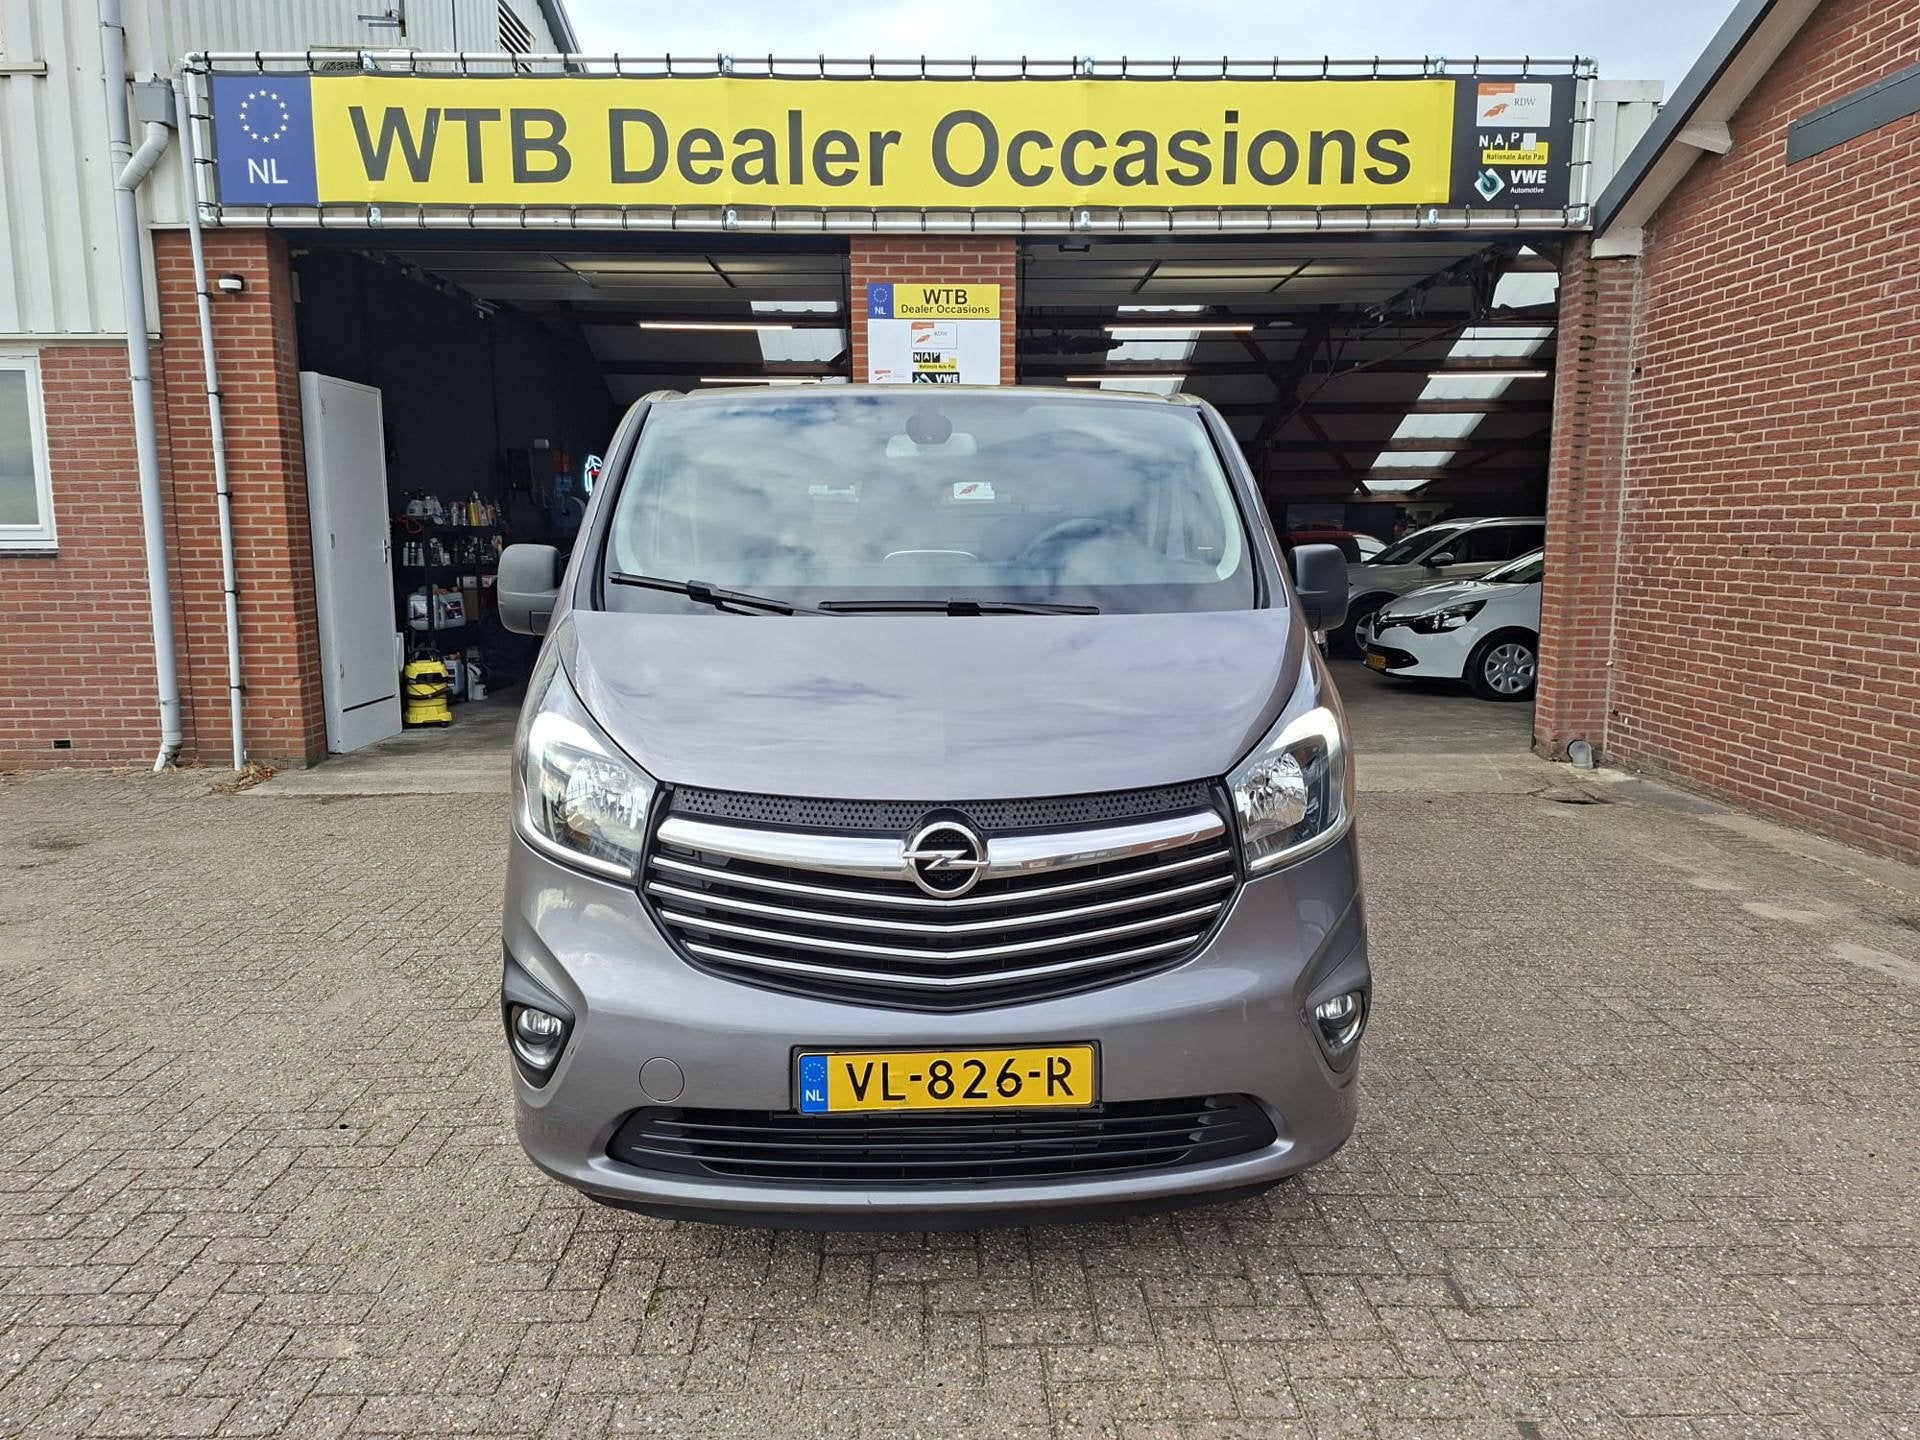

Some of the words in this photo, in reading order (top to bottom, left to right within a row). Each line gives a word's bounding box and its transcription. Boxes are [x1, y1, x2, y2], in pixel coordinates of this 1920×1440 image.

[1514, 97, 1536, 107] RDW
[348, 106, 572, 184] WTB
[608, 109, 901, 186] Dealer
[930, 108, 1412, 187] Occasions
[1486, 151, 1515, 161] Nationale
[1518, 151, 1532, 161] Auto
[1533, 151, 1545, 161] Pas
[247, 158, 288, 185] NL
[1510, 169, 1547, 184] VWE
[923, 289, 968, 305] WTB
[874, 307, 887, 315] NL
[901, 304, 933, 314] Dealer
[936, 304, 990, 314] Occasions
[935, 374, 958, 383] VWE
[846, 1056, 1074, 1102] VL-826-R
[805, 1089, 825, 1102] NL
